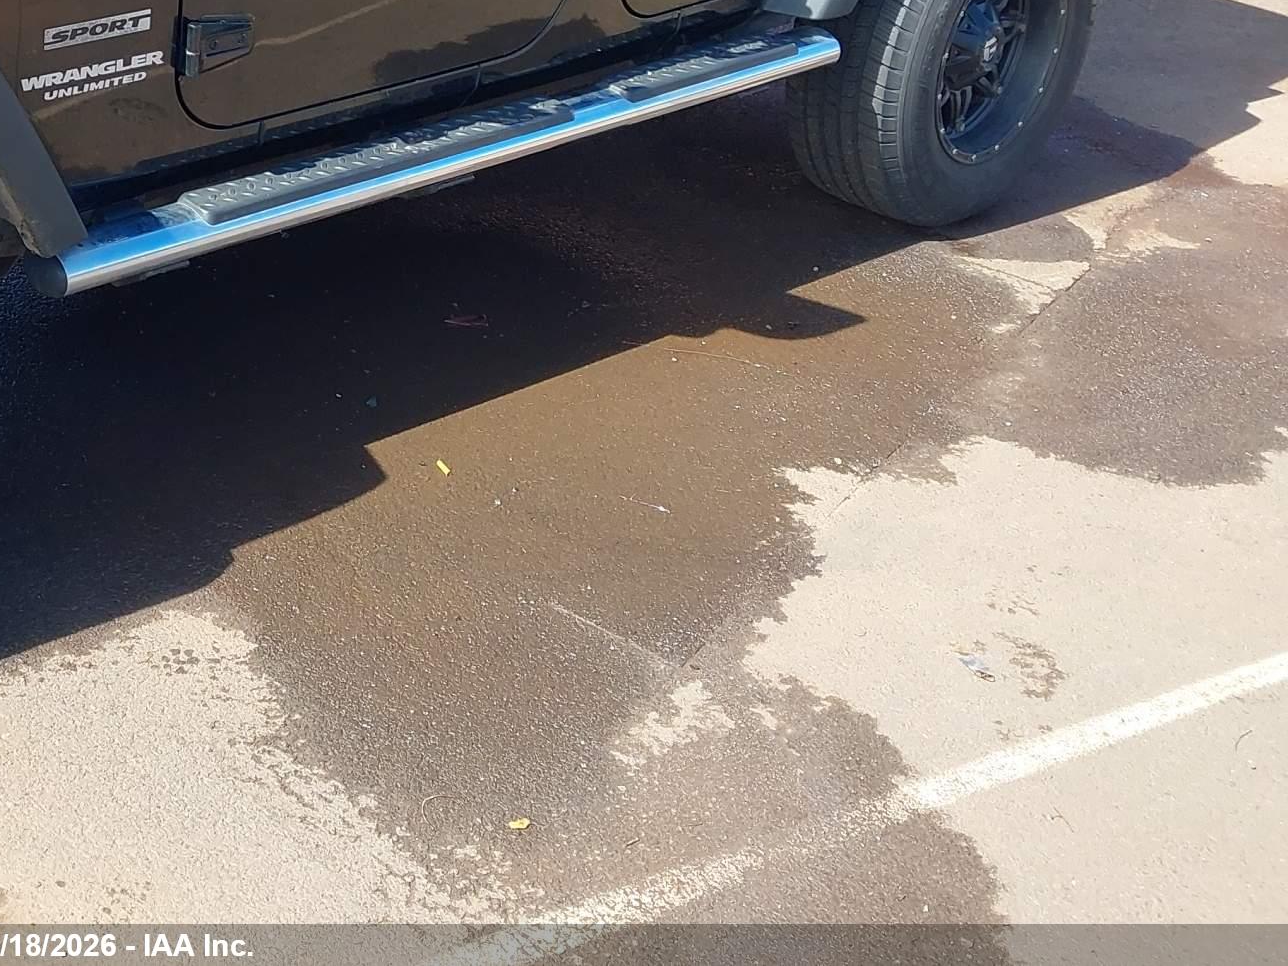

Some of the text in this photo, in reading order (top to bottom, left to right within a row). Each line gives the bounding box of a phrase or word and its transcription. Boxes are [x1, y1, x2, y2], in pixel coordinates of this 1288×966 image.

[49, 15, 146, 44] SPORT
[21, 50, 165, 92] WRANGLER
[43, 71, 147, 101] UNLIMITED
